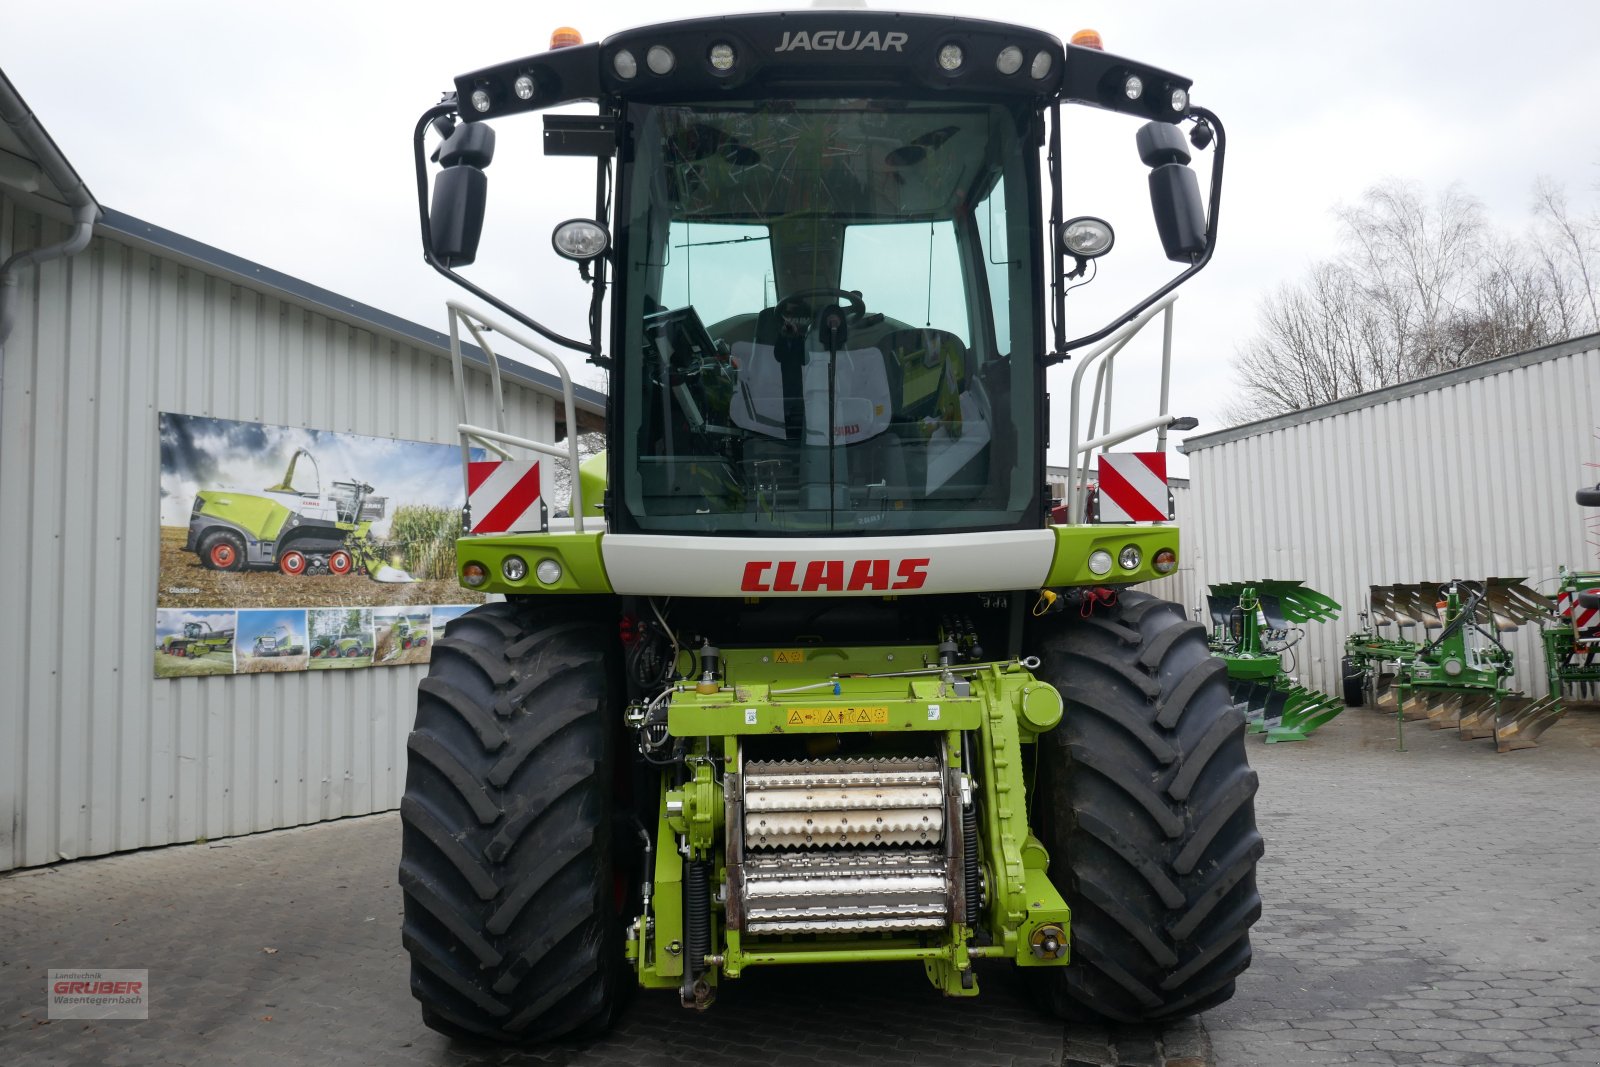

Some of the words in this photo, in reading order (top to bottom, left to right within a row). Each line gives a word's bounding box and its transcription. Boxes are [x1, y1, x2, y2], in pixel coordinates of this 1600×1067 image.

[774, 30, 909, 52] JAGUAR
[740, 558, 930, 592] CLAAS
[169, 586, 200, 594] claas.de
